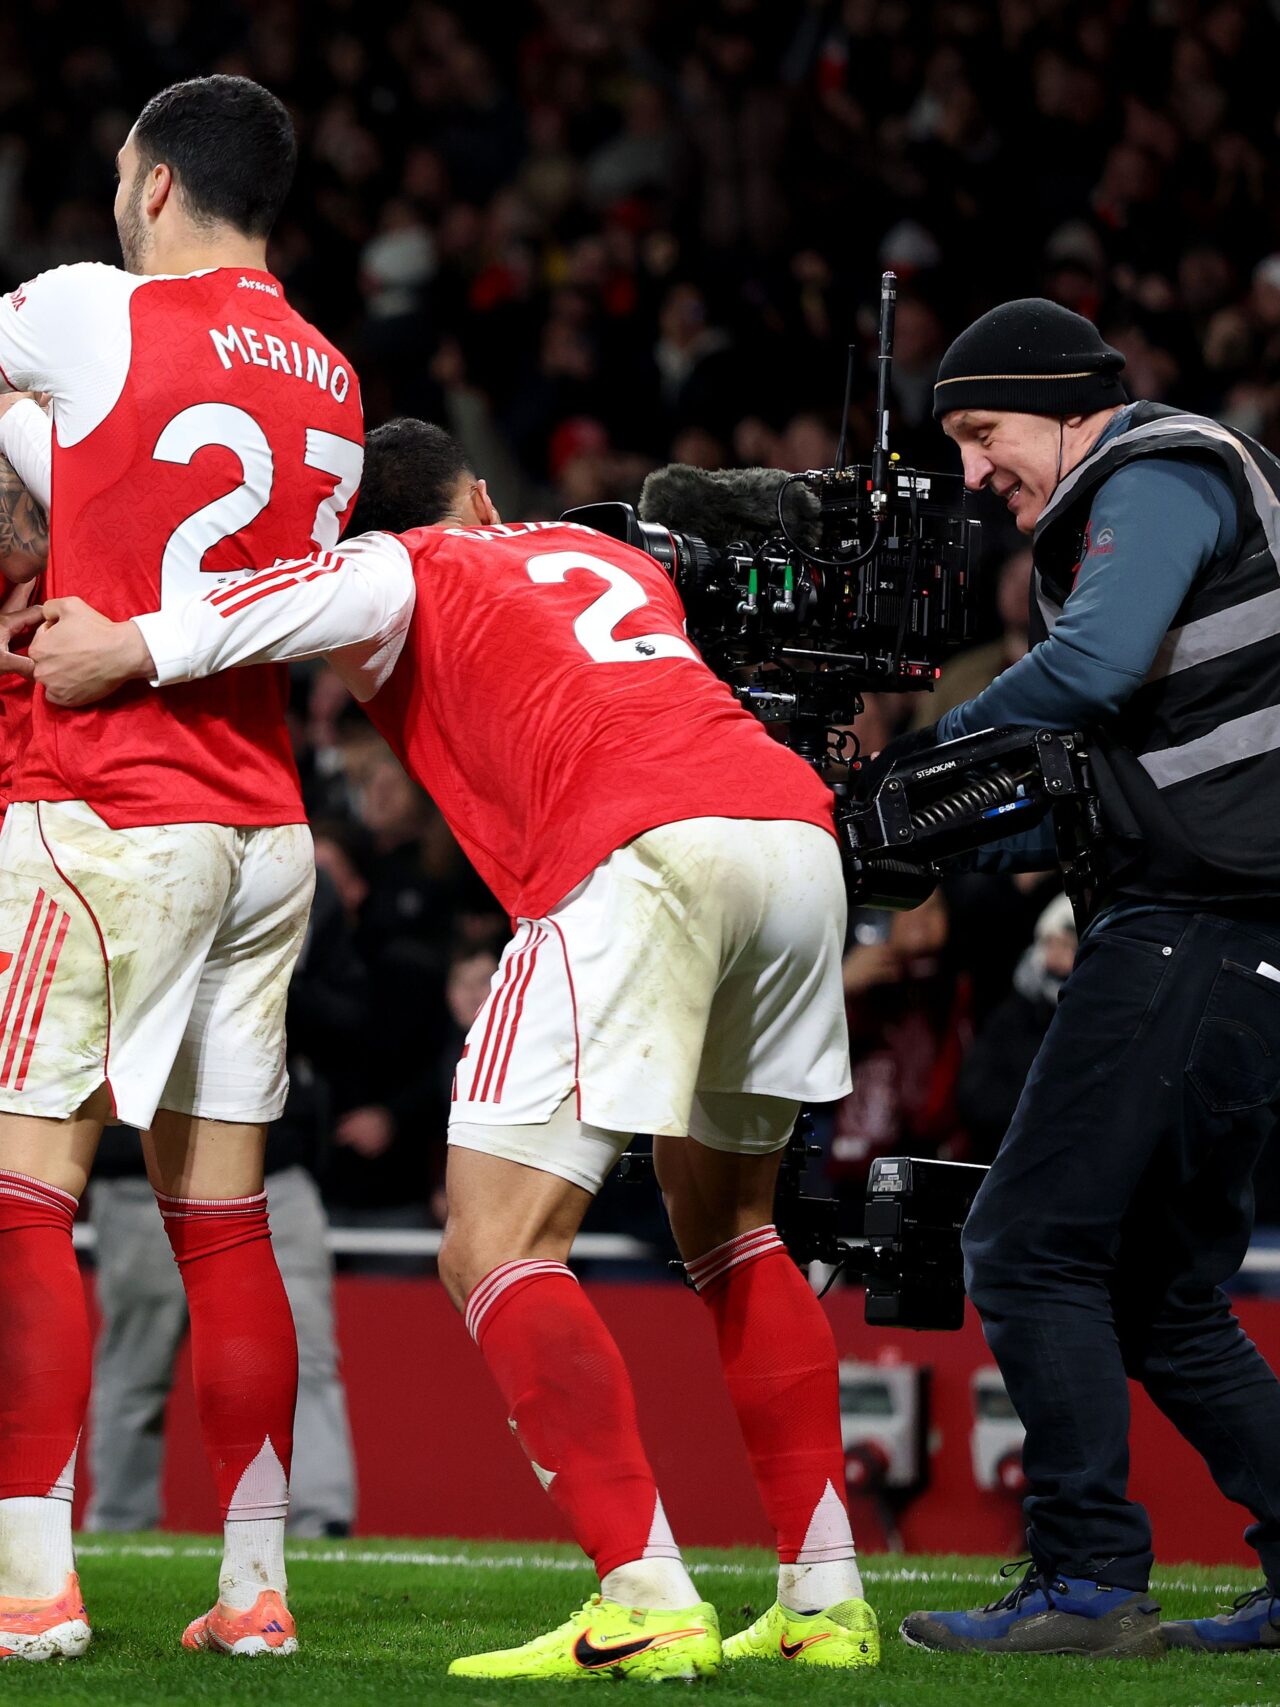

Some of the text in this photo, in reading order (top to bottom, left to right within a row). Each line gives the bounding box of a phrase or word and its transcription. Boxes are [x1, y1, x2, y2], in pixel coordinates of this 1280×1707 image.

[237, 276, 279, 298] Arsenal
[208, 324, 350, 404] MERINO
[151, 401, 365, 612] 27
[526, 550, 702, 664] 2
[916, 760, 957, 779] STEADICAM
[998, 802, 1016, 815] G-50
